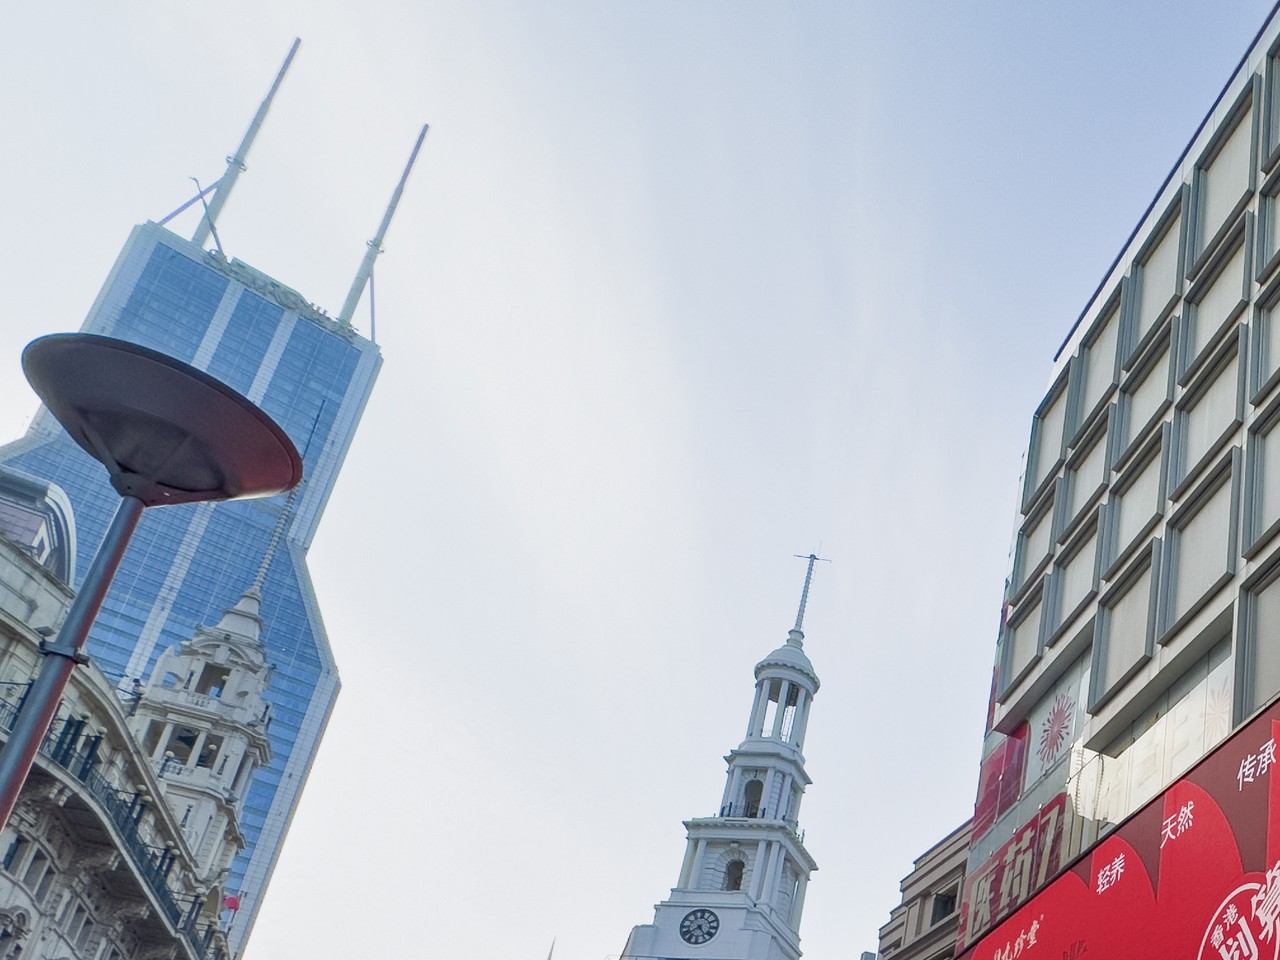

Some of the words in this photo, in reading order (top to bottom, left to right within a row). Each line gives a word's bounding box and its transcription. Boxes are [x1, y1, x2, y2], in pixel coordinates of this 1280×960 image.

[1237, 738, 1278, 792] 传承
[1160, 801, 1195, 850] 天然
[1096, 852, 1125, 895] 轻养
[1210, 903, 1239, 950] 香港
